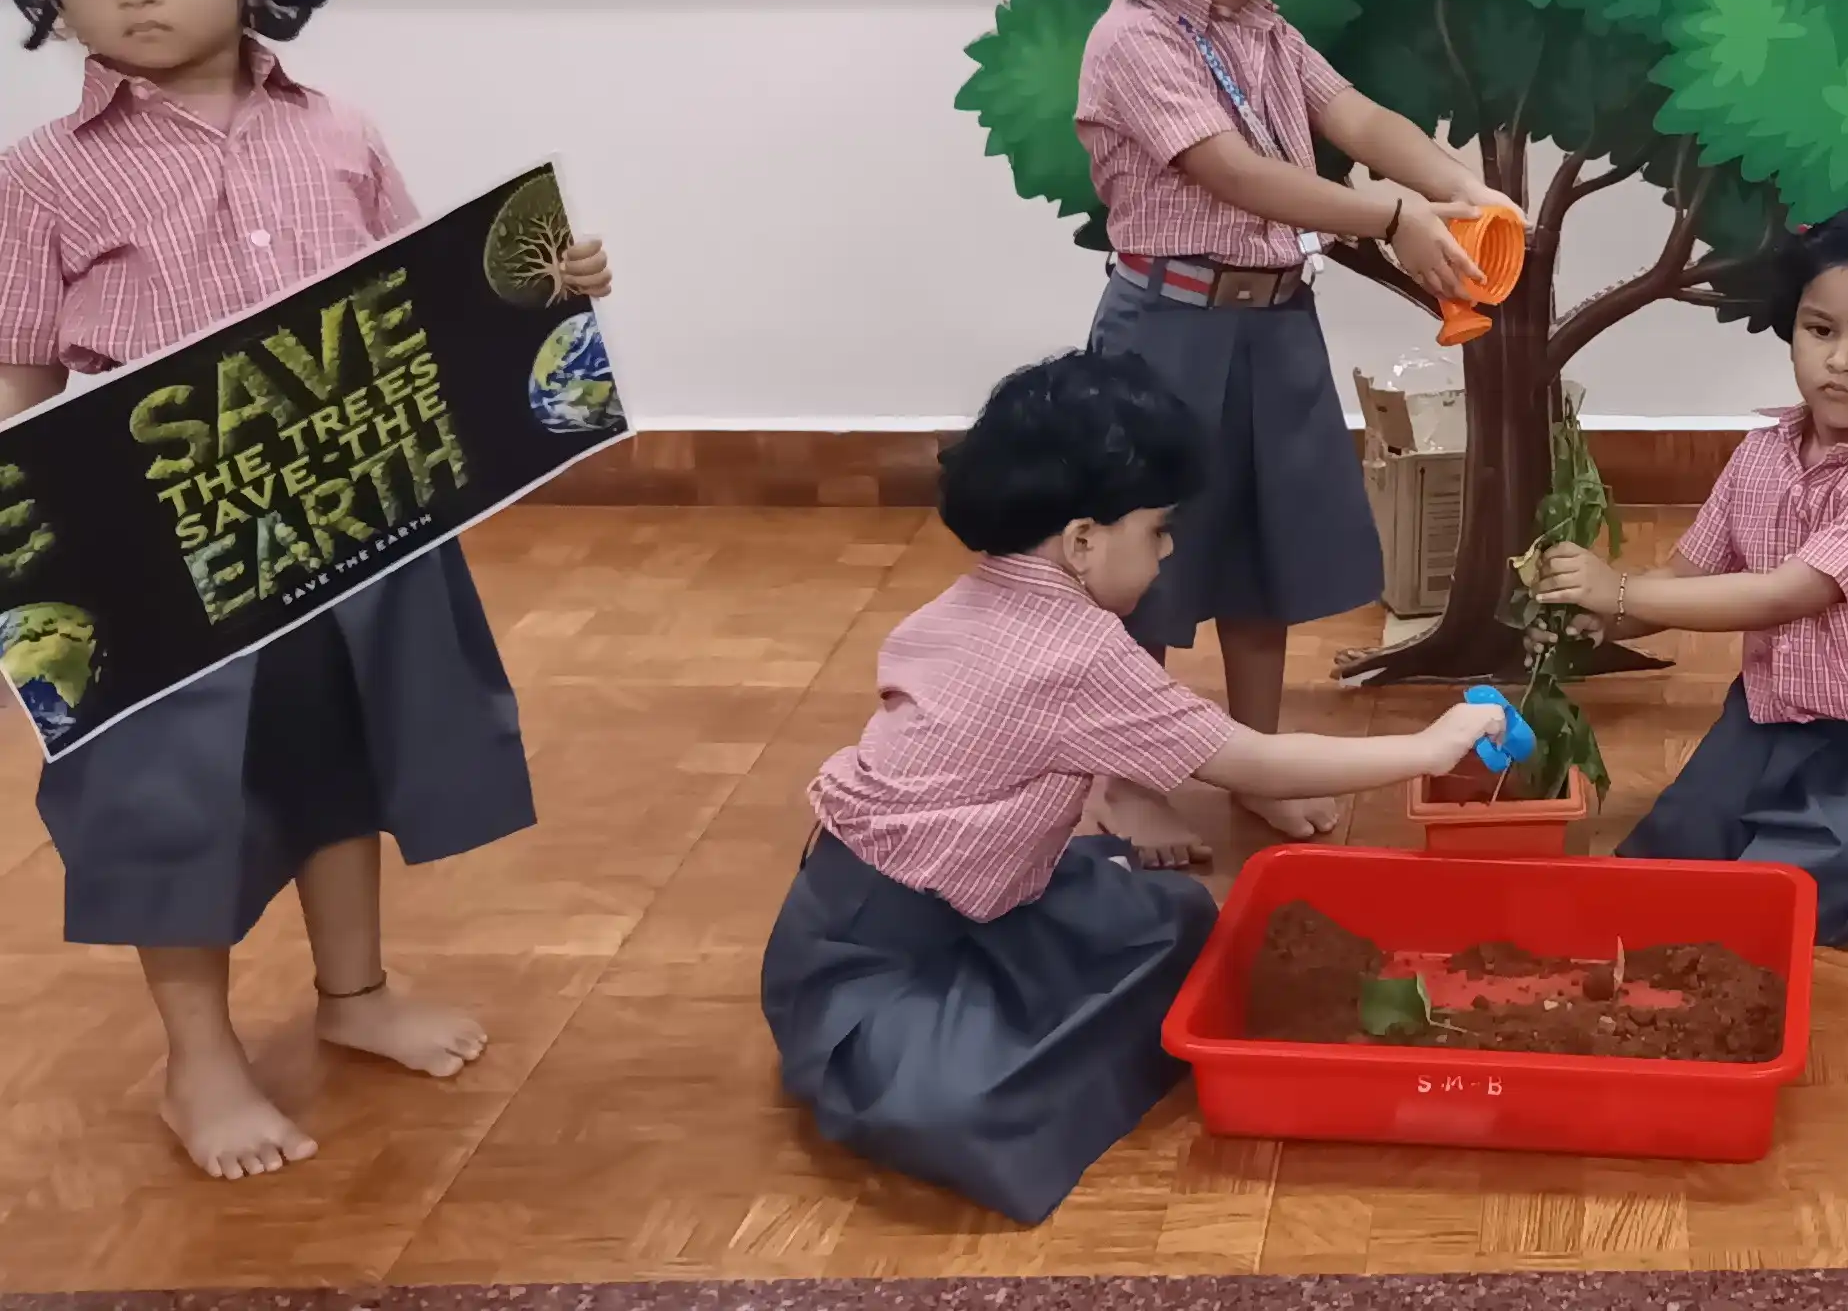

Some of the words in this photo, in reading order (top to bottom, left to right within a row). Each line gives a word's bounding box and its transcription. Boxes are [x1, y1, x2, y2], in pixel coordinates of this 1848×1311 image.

[130, 267, 427, 479] SAVE
[157, 443, 272, 517] THE
[278, 352, 438, 455] TREES
[183, 413, 469, 626] EARTH
[335, 549, 370, 573] THE
[375, 513, 432, 551] EARTH
